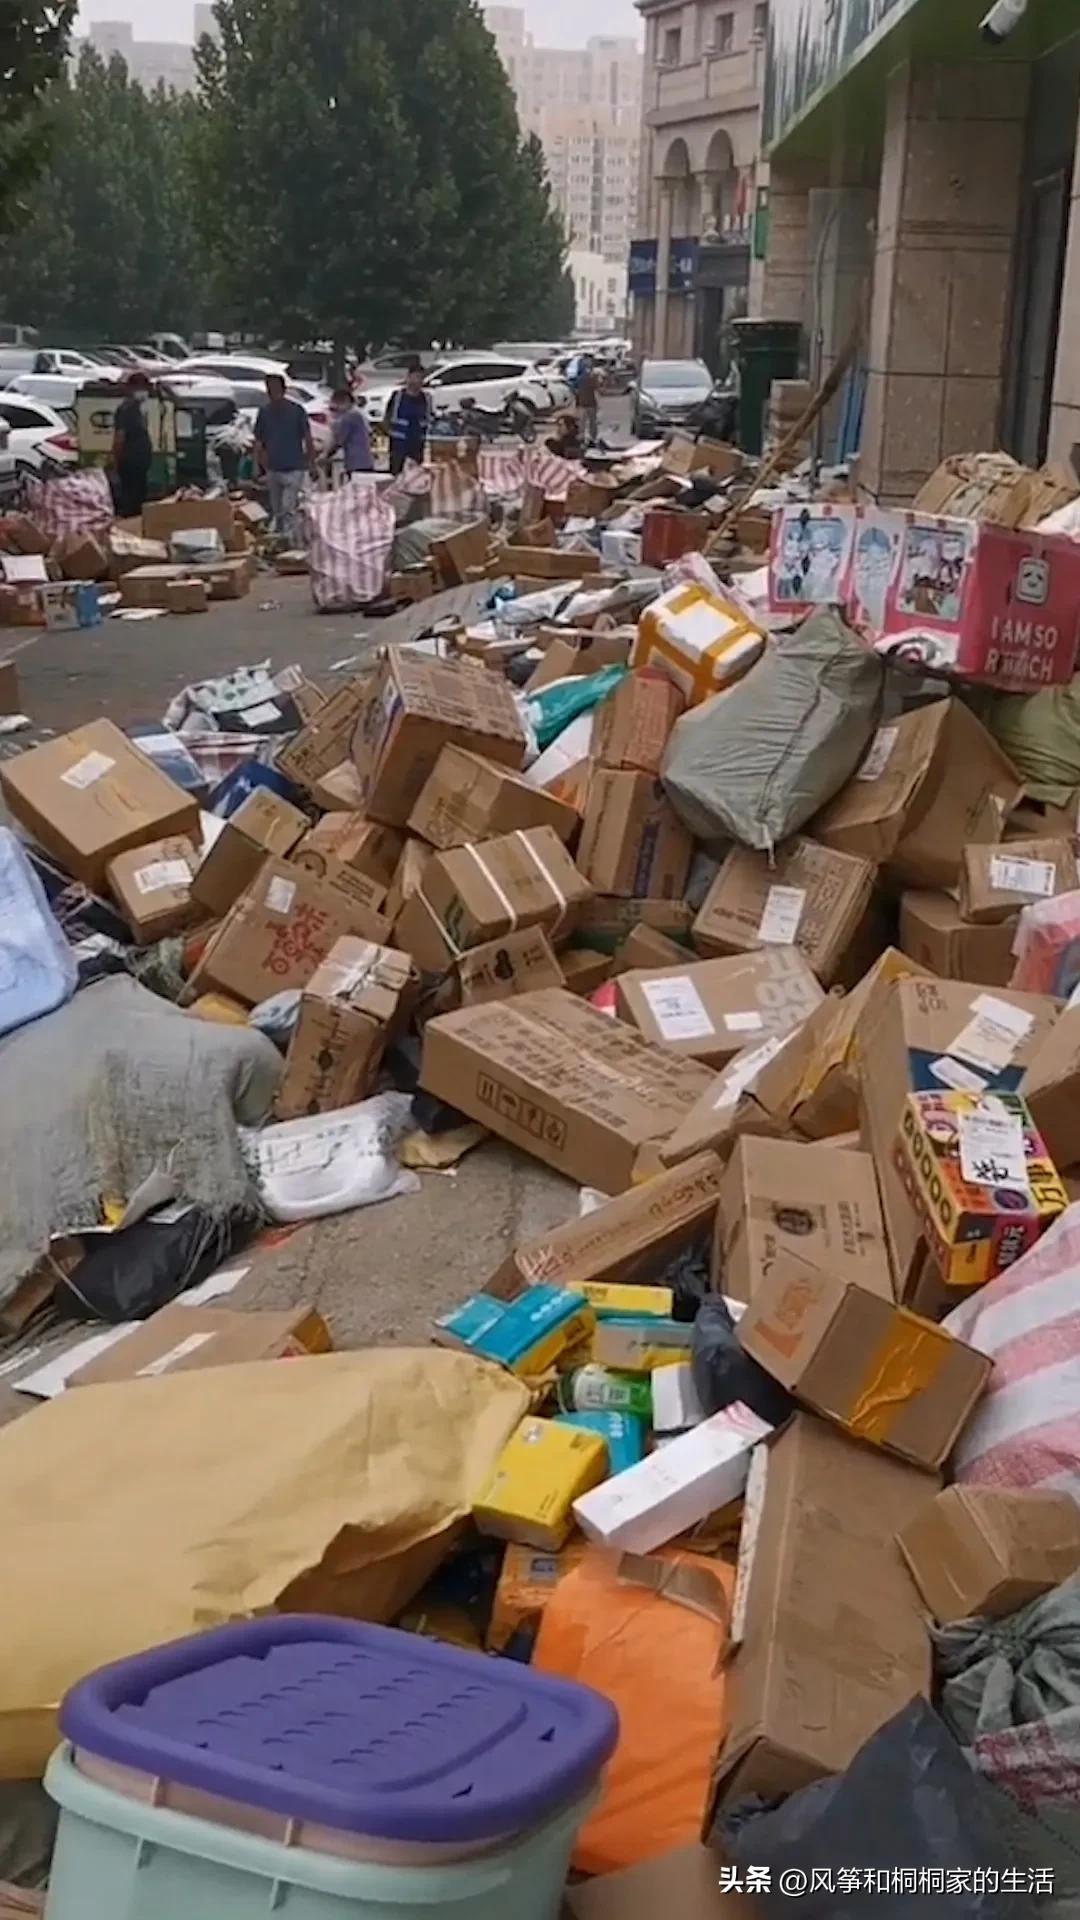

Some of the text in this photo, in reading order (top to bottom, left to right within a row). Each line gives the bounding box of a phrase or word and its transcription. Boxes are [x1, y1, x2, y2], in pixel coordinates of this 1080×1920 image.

[991, 616, 1058, 651] I AM SO
